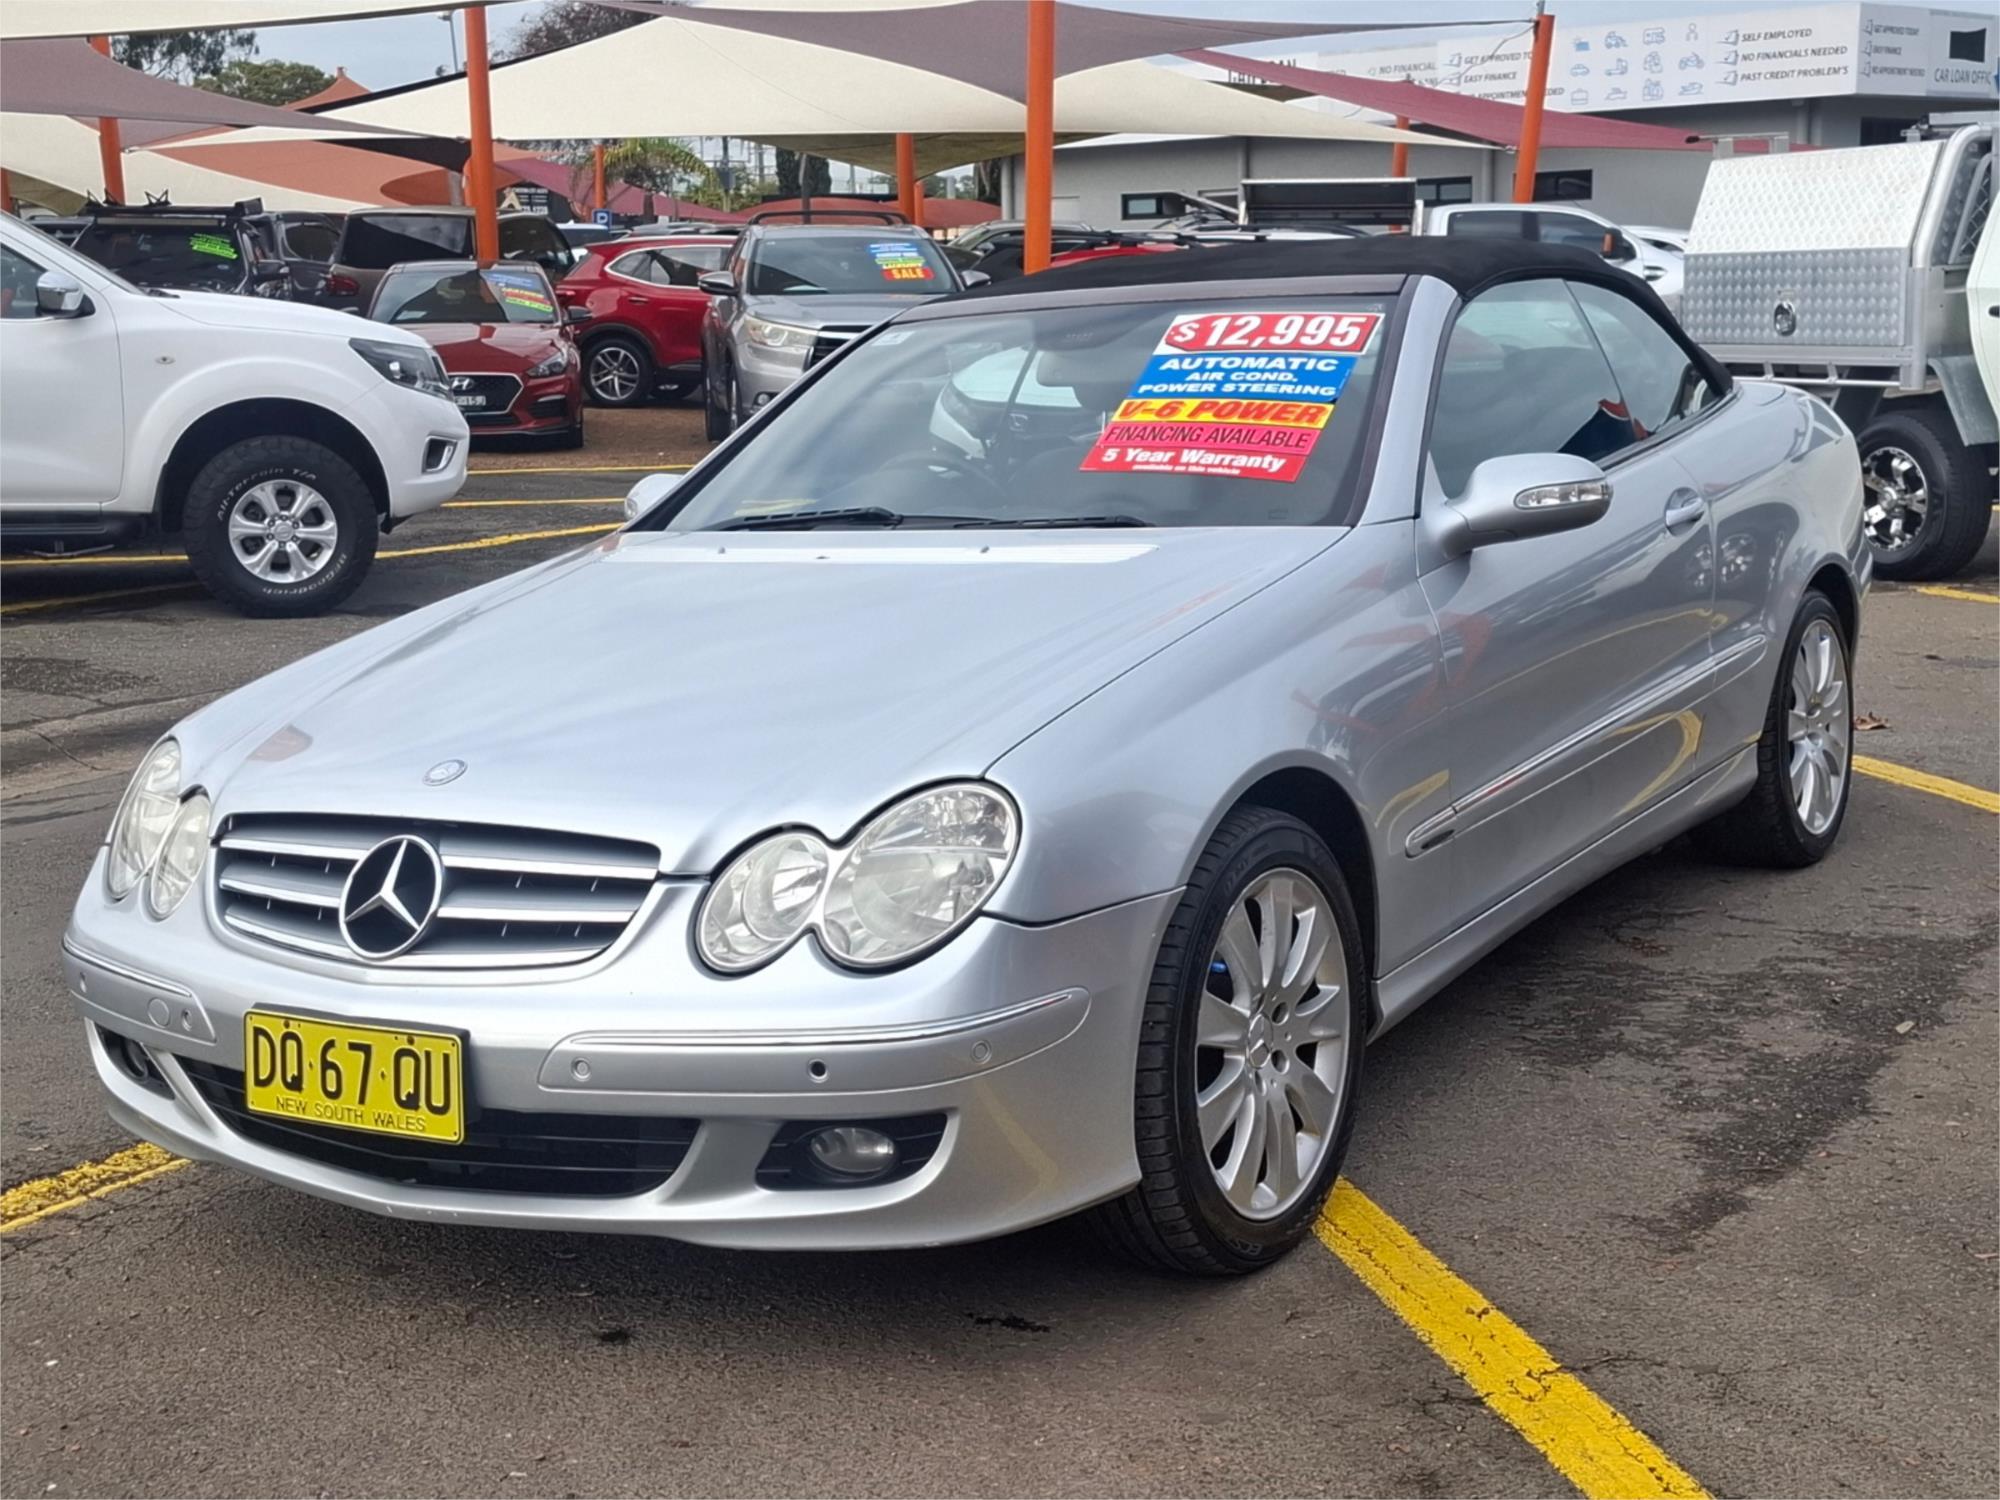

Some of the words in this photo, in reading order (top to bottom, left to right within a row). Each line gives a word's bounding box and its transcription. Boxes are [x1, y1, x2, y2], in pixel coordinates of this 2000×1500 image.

[1741, 32, 1762, 42] SELF
[1763, 28, 1812, 41] EMPLOYED
[1464, 56, 1479, 65] GET
[1481, 53, 1522, 65] APPROVED
[1741, 53, 1755, 62] NO
[1756, 48, 1809, 61] FINANCIALS
[1810, 45, 1848, 56] NEEDED
[1464, 74, 1484, 84] EASY
[1485, 71, 1517, 83] FINANCE
[1740, 72, 1762, 82] PAST
[1764, 70, 1795, 80] CREDIT
[1796, 65, 1849, 78] PROBLEM'S
[1934, 67, 1949, 82] CAR
[1951, 68, 1970, 83] LOAN
[891, 268, 925, 279] SALE
[1159, 356, 1339, 372] AUTOMATIC
[1185, 371, 1221, 382] AIR
[1226, 371, 1298, 383] COND.
[1138, 384, 1218, 394] POWER
[1221, 384, 1336, 397] STEERING
[1119, 400, 1181, 420] V-6
[1187, 401, 1328, 424] POWER
[1105, 426, 1204, 443] FINANCING
[1207, 427, 1311, 449] AVAILABLE
[1102, 448, 1117, 463] 5
[1125, 448, 1173, 463] Year
[1180, 449, 1287, 474] Warranty
[276, 1096, 308, 1115] NEW
[314, 1102, 364, 1122] SOUTH
[372, 1111, 426, 1132] WALES
